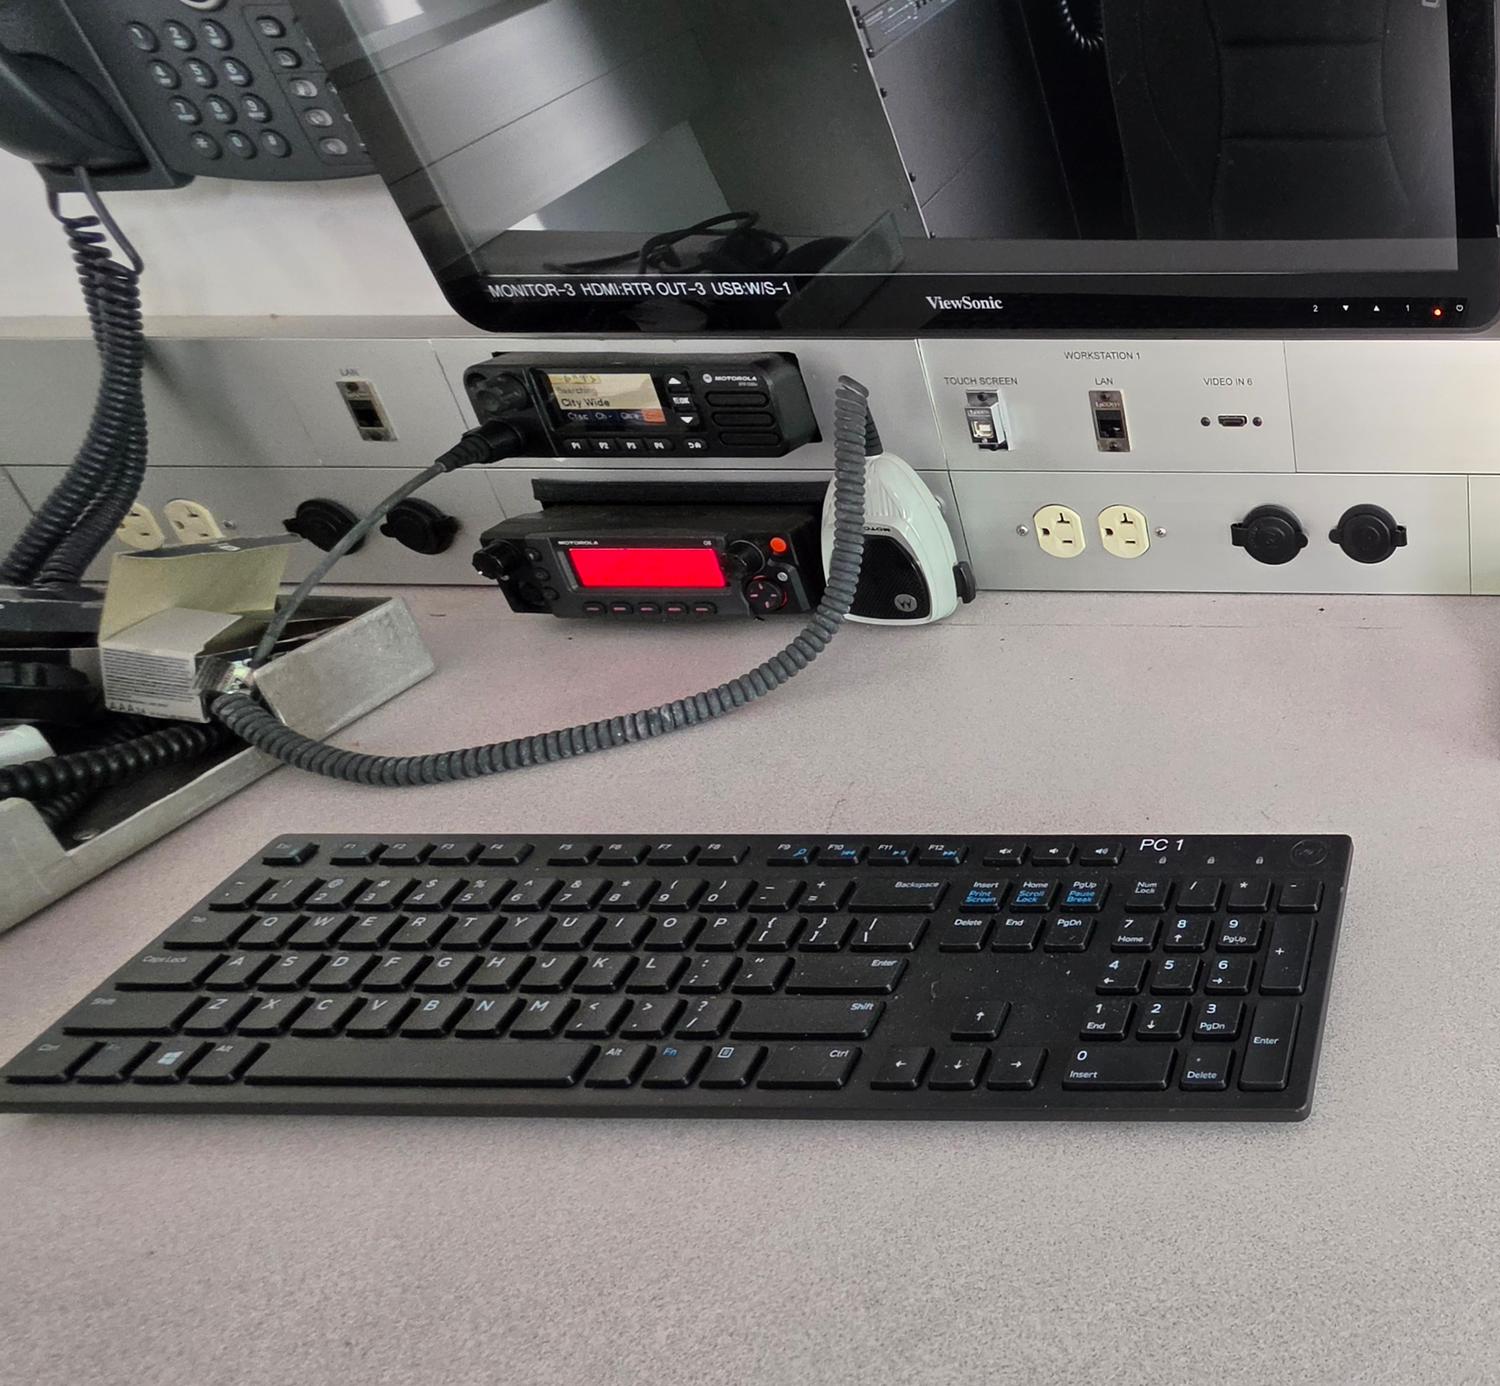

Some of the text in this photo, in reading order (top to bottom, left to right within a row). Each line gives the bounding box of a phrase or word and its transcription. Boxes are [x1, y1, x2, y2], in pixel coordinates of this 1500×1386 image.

[488, 281, 792, 298] MONITOR-3 HDMI:RTR OUT-3 USB:W/S-1
[926, 296, 1003, 311] ViewSonic
[1064, 352, 1133, 360] WORKSTATION
[944, 377, 1018, 386] TOUCH SCREEN
[1095, 378, 1114, 386] LAN
[1203, 378, 1233, 386] VIDEO
[1235, 378, 1245, 386] IN
[586, 398, 611, 407] Wide
[1140, 839, 1185, 851] PC 1
[895, 881, 939, 889] Backspace
[1023, 881, 1049, 889] Home
[1073, 882, 1097, 890] PgUp
[314, 916, 335, 927] W
[361, 916, 378, 927] E
[412, 916, 427, 927] R
[514, 917, 528, 927] Y
[562, 917, 578, 927] U
[714, 918, 728, 928] P
[1006, 919, 1024, 927] End
[1057, 919, 1082, 928] PgDn
[1124, 920, 1134, 928] 7
[1177, 920, 1187, 928] 8
[1228, 920, 1239, 928] 9
[1223, 936, 1247, 944] PgUp
[1109, 960, 1120, 970] 4
[1164, 960, 1175, 970] 5
[1218, 960, 1229, 970] 6
[850, 1003, 874, 1011] Shift
[1150, 1004, 1161, 1014] 2
[1206, 1004, 1217, 1014] 3
[1086, 1022, 1106, 1030] End
[1200, 1022, 1225, 1030] PgDn
[1254, 1036, 1279, 1045] Enter
[606, 1048, 623, 1056] Alt
[662, 1048, 678, 1056] Fn
[829, 1050, 849, 1058] Ctrl
[1076, 1050, 1088, 1061] 0
[1070, 1070, 1098, 1078] Insert
[1187, 1071, 1218, 1079] Delete
